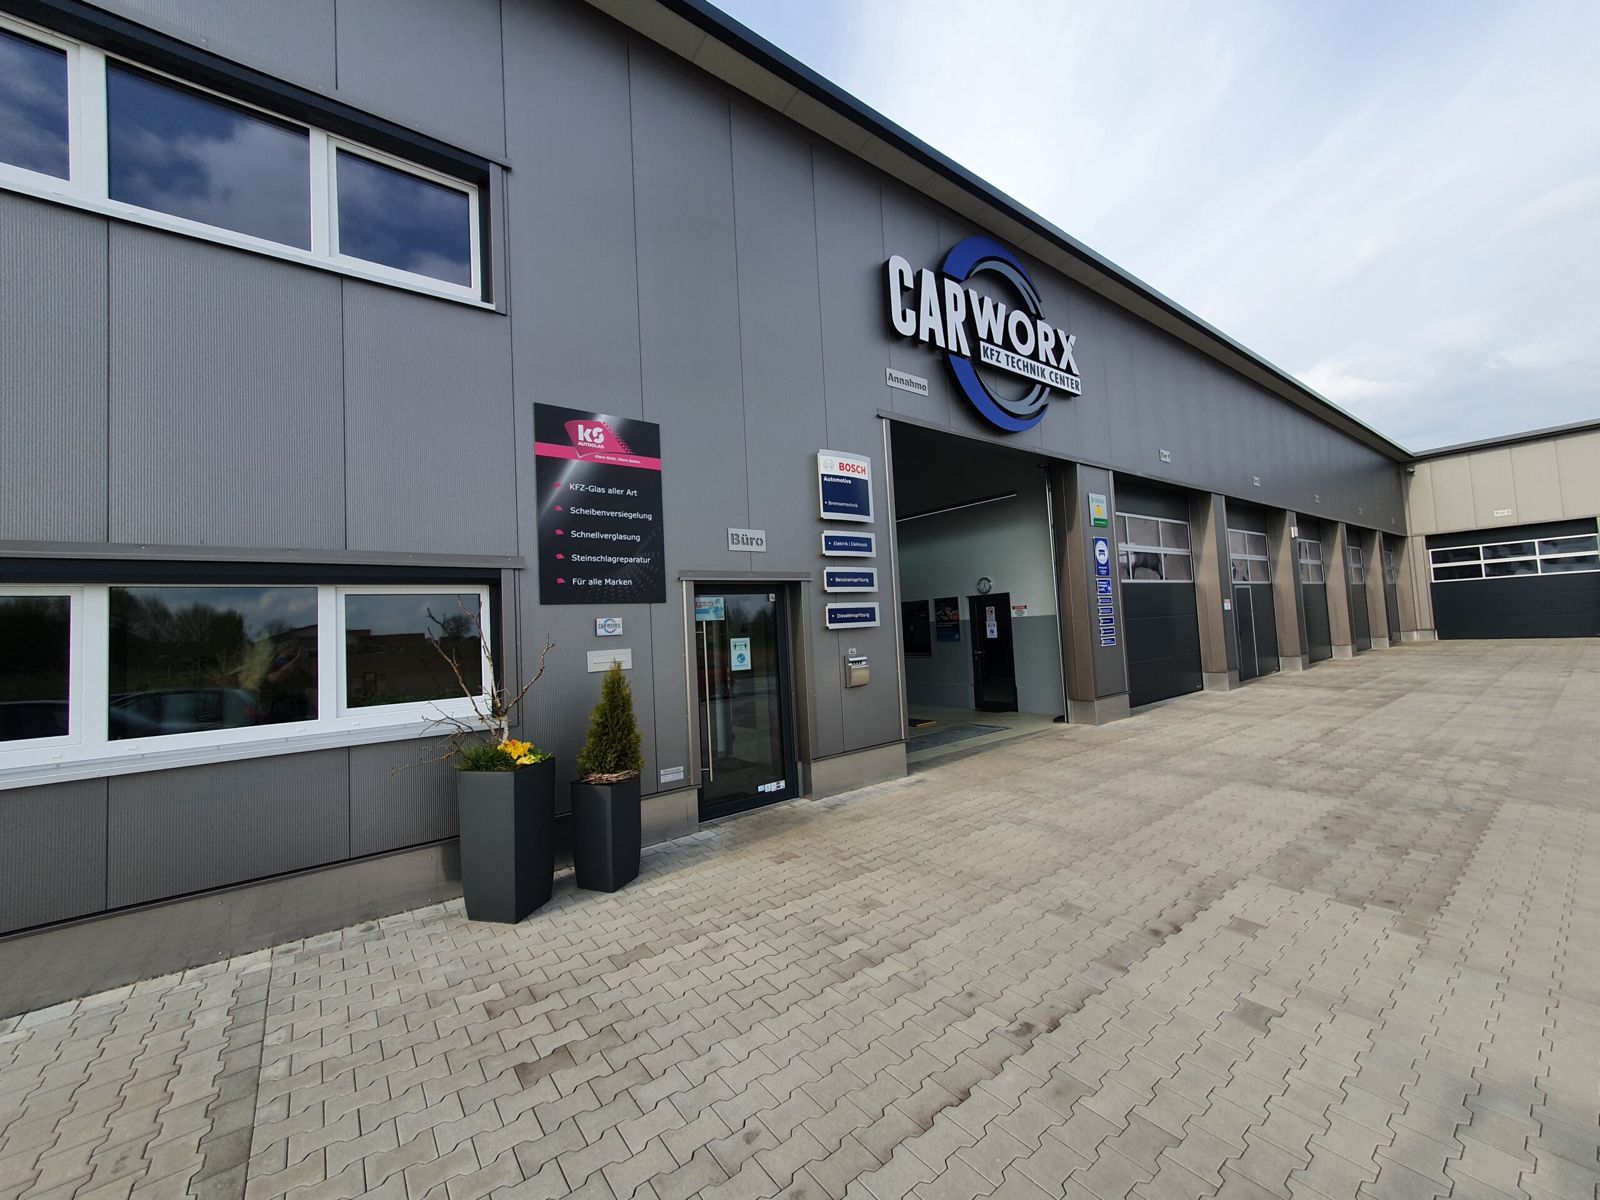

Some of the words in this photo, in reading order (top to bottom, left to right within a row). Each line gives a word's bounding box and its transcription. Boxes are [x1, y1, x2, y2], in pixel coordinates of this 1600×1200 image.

[888, 255, 1079, 376] CARWORX
[982, 345, 1001, 364] KFZ
[1004, 353, 1046, 380] TECHNIK
[1049, 370, 1080, 392] CENTER
[888, 372, 927, 391] Annahme
[577, 441, 605, 449] AUTOGLAS
[838, 462, 866, 475] BOSCH
[823, 476, 852, 484] Automotive
[569, 483, 606, 493] KFZ-Glas
[607, 487, 624, 495] aller
[626, 489, 638, 497] Art
[570, 506, 653, 521] Scheibenversiegelung
[570, 530, 641, 542] Schnellverglasung
[730, 533, 764, 546] Büro
[571, 554, 651, 564] Steinschlagreparatur
[572, 577, 586, 586] Für
[588, 578, 602, 586] alle
[604, 578, 633, 586] Marken
